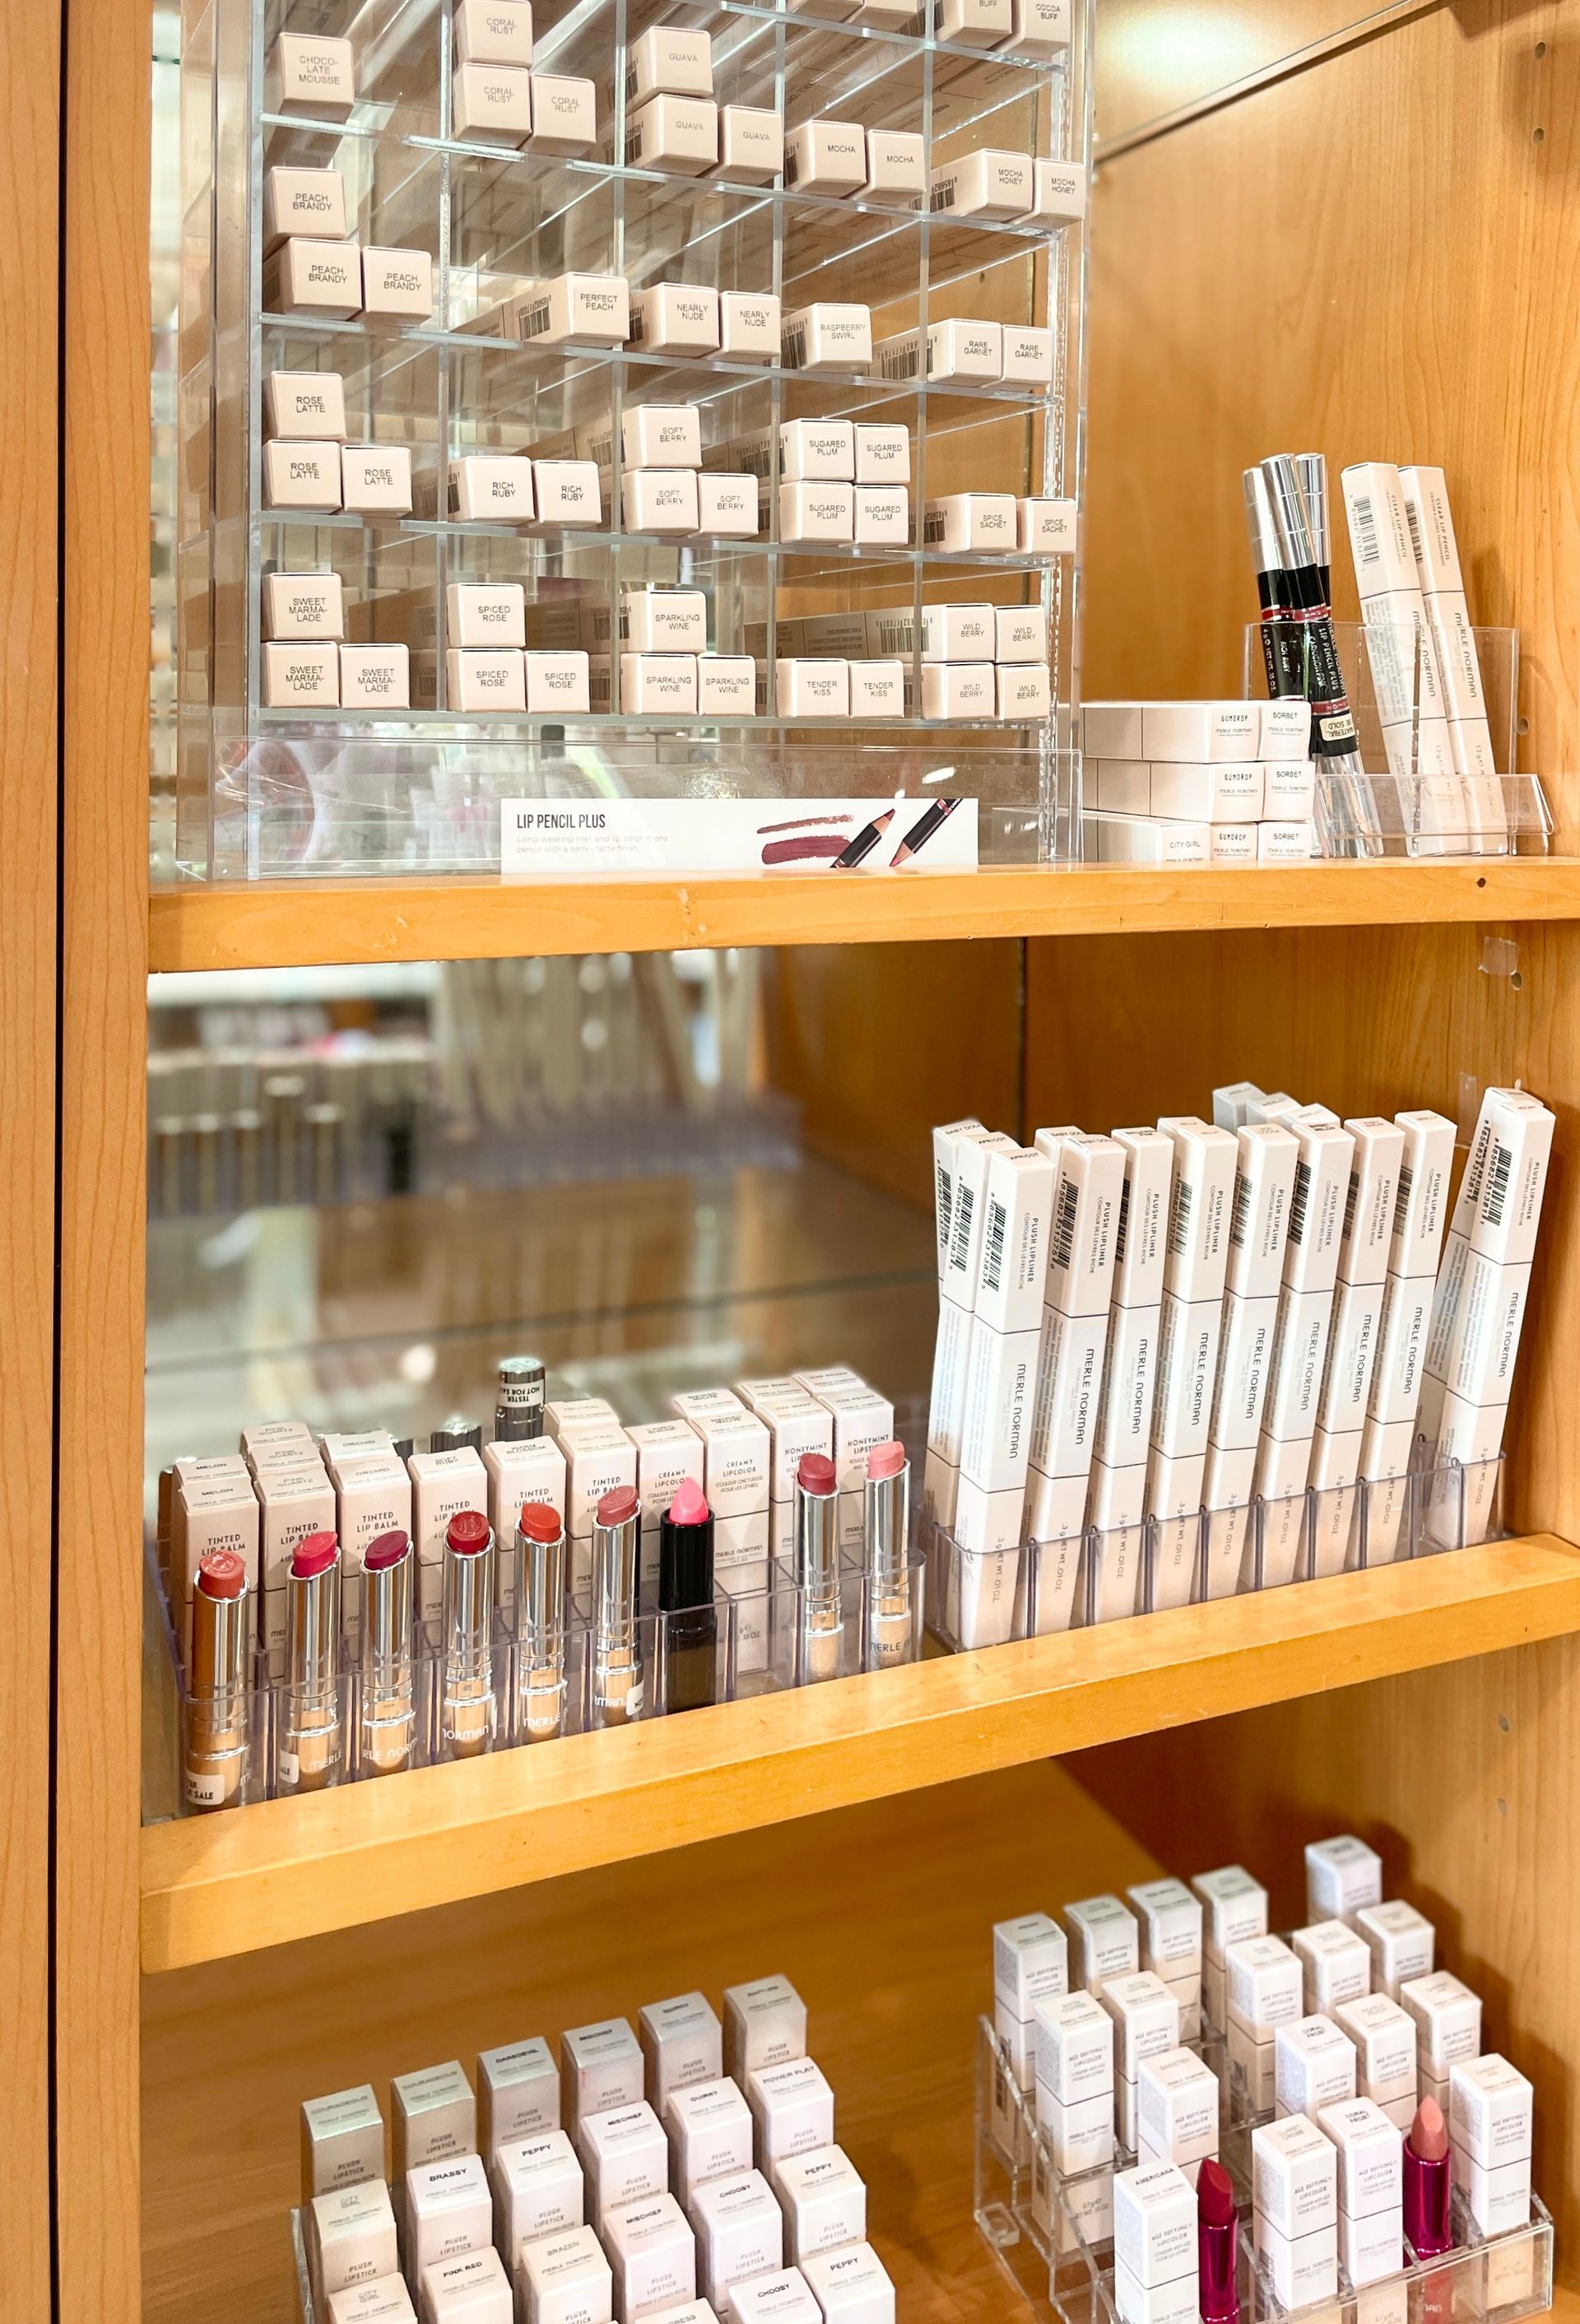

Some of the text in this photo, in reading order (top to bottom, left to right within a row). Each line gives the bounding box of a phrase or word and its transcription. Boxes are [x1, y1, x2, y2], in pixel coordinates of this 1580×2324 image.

[1036, 4, 1060, 12] COCOA
[486, 18, 517, 28] CORAL
[490, 26, 514, 35] RUST
[300, 56, 338, 66] CHOCO-
[669, 53, 698, 62] GUAVA
[307, 65, 330, 74] LATE
[299, 74, 340, 84] MOUSSE
[484, 87, 514, 98] CORAL
[488, 95, 510, 103] RUST
[828, 145, 855, 153] MOCHA
[887, 155, 913, 164] MOCHA
[998, 169, 1022, 177] MOCHA
[999, 176, 1022, 184] HONEY
[295, 194, 328, 203] PEACH
[293, 202, 332, 211] BRANDY
[387, 273, 417, 282] PEACH
[383, 281, 421, 290] BRANDY
[580, 294, 617, 303] PERFECT
[586, 302, 613, 311] PEACH
[677, 304, 708, 312] NEARLY
[682, 312, 704, 320] NUDE
[740, 310, 770, 318] NEARLY
[745, 318, 765, 327] NUDE
[831, 331, 855, 339] SWIRL
[969, 341, 988, 349] RARE
[964, 347, 992, 356] GARNET
[296, 397, 323, 405] ROSE
[296, 404, 325, 412] LATTE
[810, 440, 846, 449] SUGARED
[867, 444, 902, 453] SUGARED
[365, 469, 391, 477] ROSE
[365, 476, 393, 486] LATTE
[492, 489, 516, 497] RUBY
[1392, 495, 1400, 517] CLEAR
[293, 598, 326, 607] SWEET
[289, 606, 327, 614] MARMA-
[478, 606, 510, 614] SPICED
[297, 614, 321, 622] LADE
[1455, 612, 1476, 698] MERLE NORMAN
[1323, 643, 1331, 669] PENCIL
[1330, 672, 1338, 690] PLUS
[1423, 651, 1435, 697] NORMAN
[358, 676, 395, 685] MARMA-
[814, 688, 831, 696] KISS
[518, 815, 606, 828] LIP PENCIL PLUS
[1211, 1191, 1224, 1253] PLUSH LIPLINER
[1378, 1206, 1387, 1240] LIPLINER
[1099, 1202, 1111, 1267] PLUSH LIPLINER
[1271, 1216, 1280, 1251] LIPLINER
[1499, 1292, 1518, 1378] MERLE NORMAN
[1352, 1314, 1371, 1402] MERLE NORMAN
[1192, 1332, 1208, 1425] MERLE NORMAN
[1245, 1328, 1266, 1419] MERLE NORMAN
[1132, 1339, 1147, 1434] MERLE NORMAN
[1076, 1348, 1094, 1444] MERLE NORMAN
[1009, 1364, 1026, 1458] MERLE NORMAN
[848, 1434, 890, 1447] HONEYMINT
[785, 1443, 827, 1455] HONEYMINT
[727, 1459, 753, 1468] CREAMY
[356, 1466, 389, 1476] ORCHID
[658, 1469, 685, 1479] CREAMY
[723, 1466, 756, 1477] LIPCOLOR
[202, 1488, 234, 1496] MELON
[519, 1489, 550, 1500] TINTED
[362, 1512, 394, 1523] TINTED
[286, 1523, 318, 1534] TINTED
[357, 1520, 399, 1532] LIP BALM
[207, 1534, 241, 1545] TINTED
[195, 1790, 213, 1800] SALE
[763, 2066, 814, 2085] POWER PLAY
[607, 2113, 642, 2126] MISCHIEF
[522, 2144, 551, 2156] PEPPY
[805, 2163, 832, 2175] PEPPY
[430, 2168, 467, 2182] BRASSY
[719, 2183, 750, 2198] CHOOSY
[443, 2261, 482, 2277] PINK RED
[830, 2258, 858, 2271] PEPPY
[758, 2283, 790, 2298] CHOOSY
